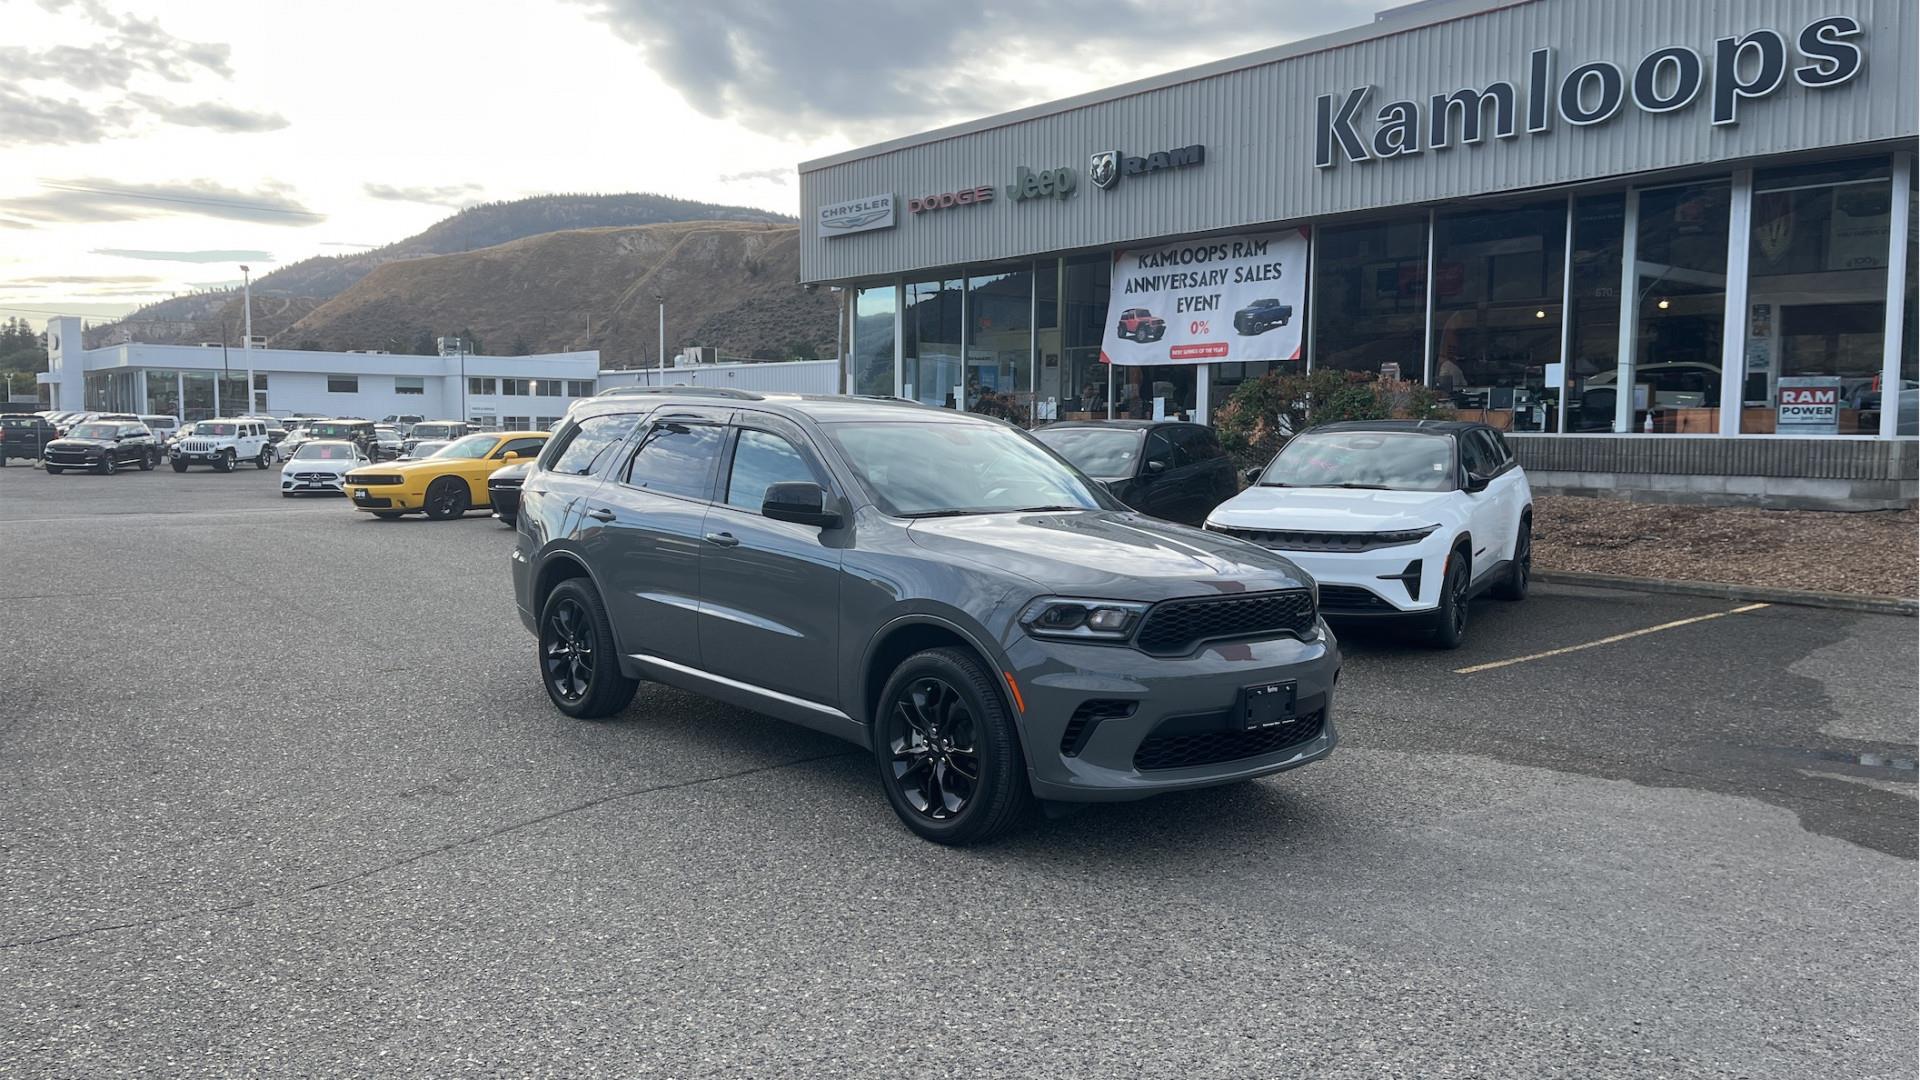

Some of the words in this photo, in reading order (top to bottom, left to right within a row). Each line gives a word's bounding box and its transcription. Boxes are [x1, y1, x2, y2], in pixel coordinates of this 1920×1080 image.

[1313, 15, 1865, 168] Kamloops
[1122, 144, 1204, 176] RAM
[1006, 166, 1076, 201] Jeep
[821, 198, 890, 218] CHRYSLER
[908, 184, 995, 214] DODGE
[1138, 246, 1228, 269] KAMLOOPS
[1232, 239, 1269, 259] RAM
[1124, 268, 1229, 295] ANNIVERSARY
[1233, 262, 1283, 284] SALES
[1176, 293, 1222, 314] EVENT
[1190, 321, 1208, 334] 0%
[1782, 390, 1835, 403] RAM
[1782, 406, 1833, 415] POWER
